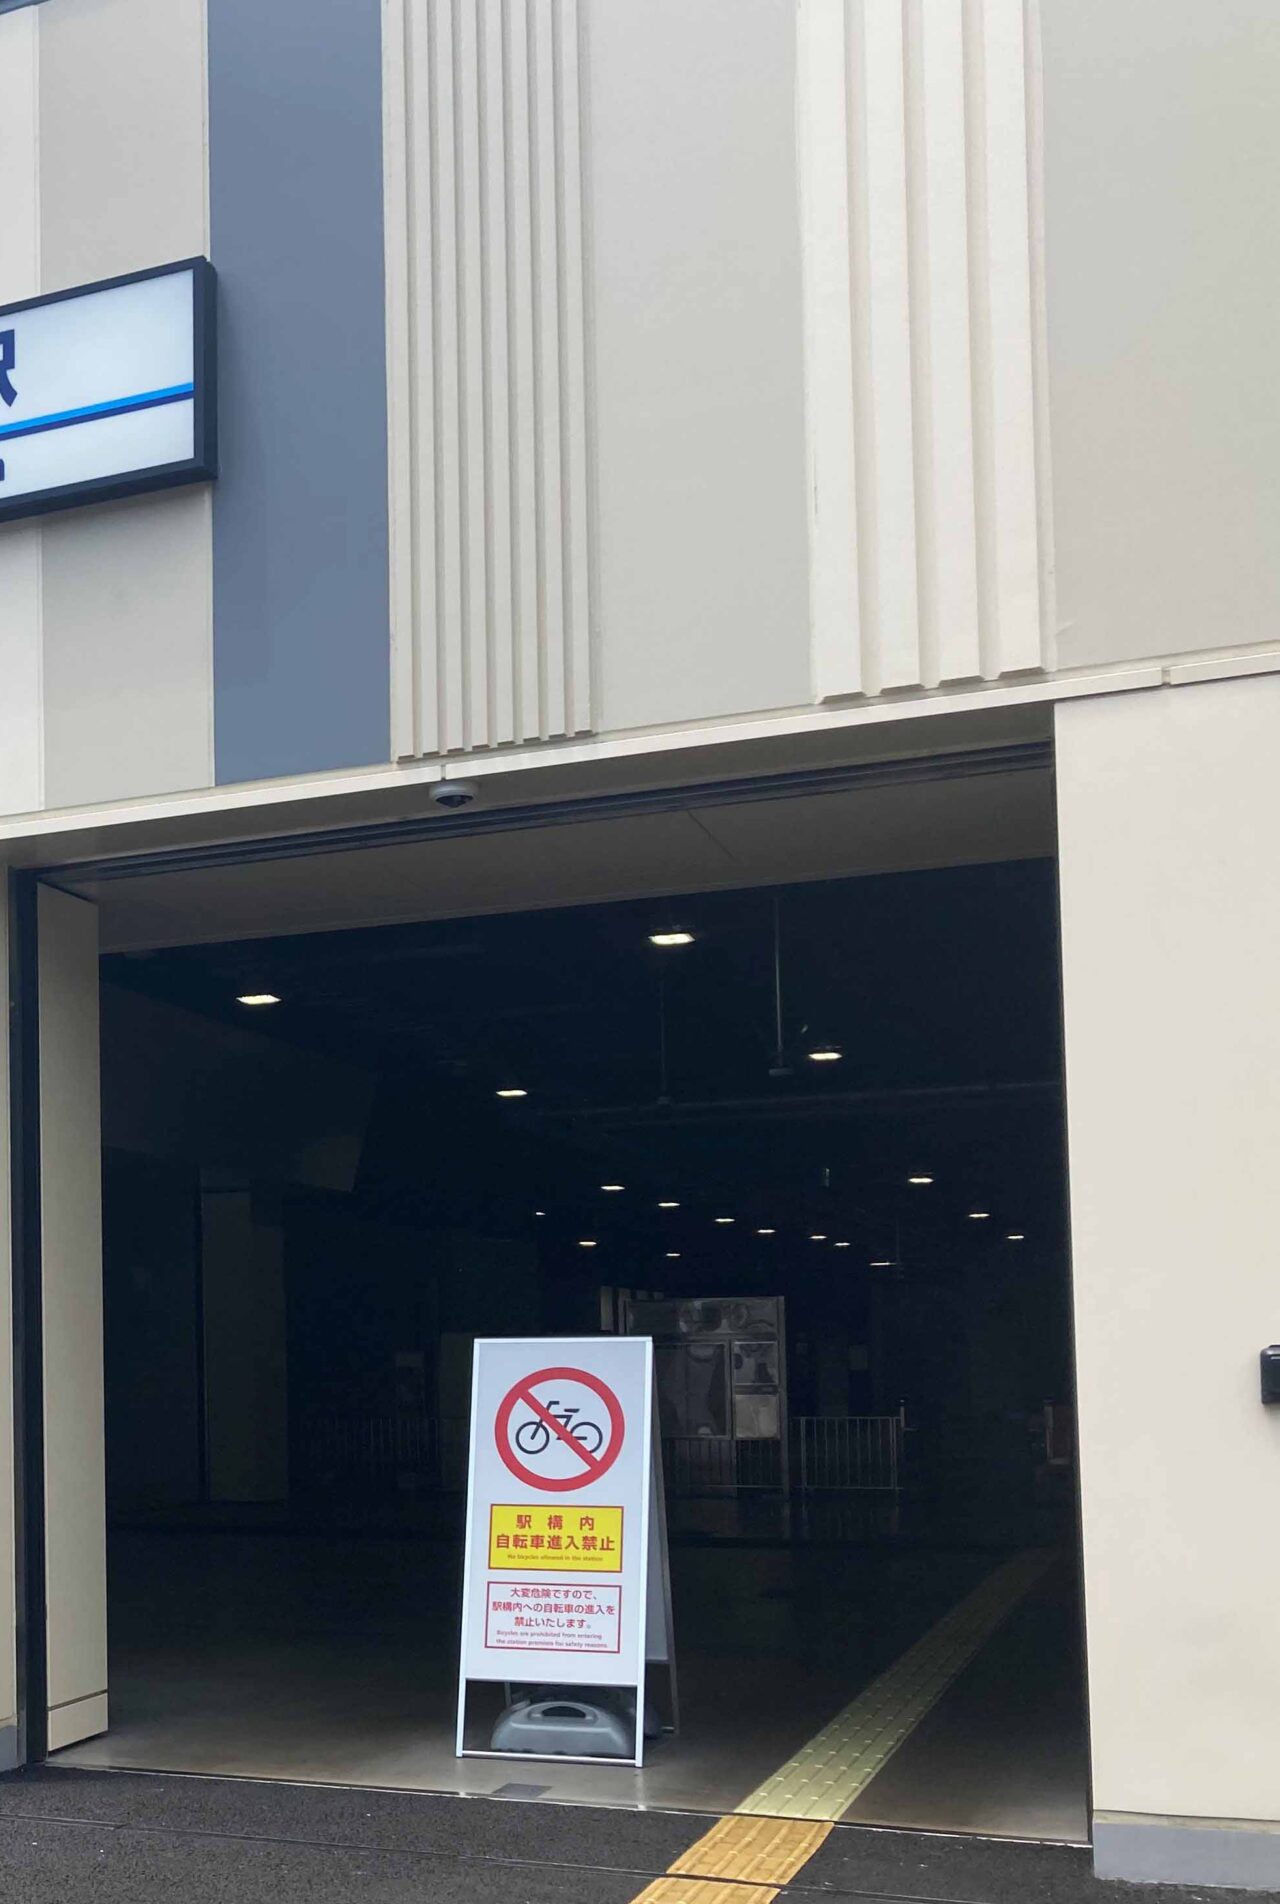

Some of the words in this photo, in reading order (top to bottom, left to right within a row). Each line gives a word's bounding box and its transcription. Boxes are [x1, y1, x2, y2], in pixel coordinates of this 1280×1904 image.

[496, 1534, 615, 1551] 自転車進入禁止
[510, 1587, 598, 1600] 大変危険ですので、
[492, 1601, 616, 1616] 駅構内への自転車の進入を
[514, 1616, 592, 1629] 禁止いたします。
